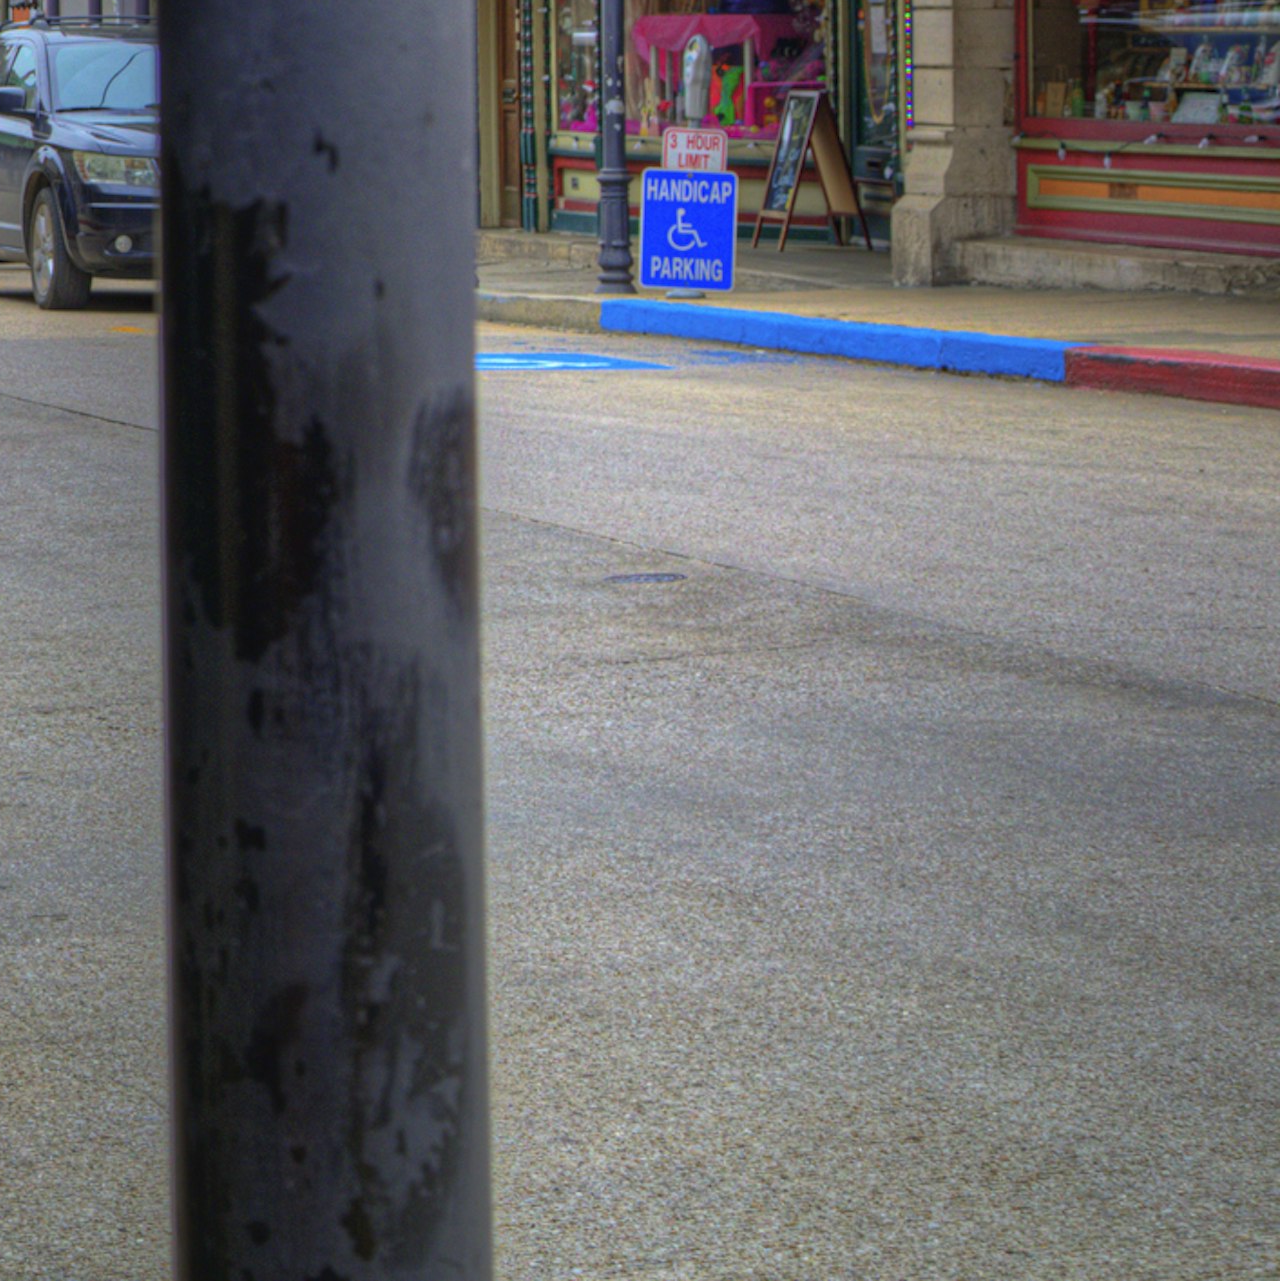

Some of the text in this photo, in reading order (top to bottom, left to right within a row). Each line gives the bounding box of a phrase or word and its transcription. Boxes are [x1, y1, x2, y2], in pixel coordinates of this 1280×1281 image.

[670, 134, 720, 151] 3 HOUR
[678, 153, 710, 169] LIMIT
[646, 177, 733, 205] HANDICAP
[650, 255, 724, 282] PARKING
